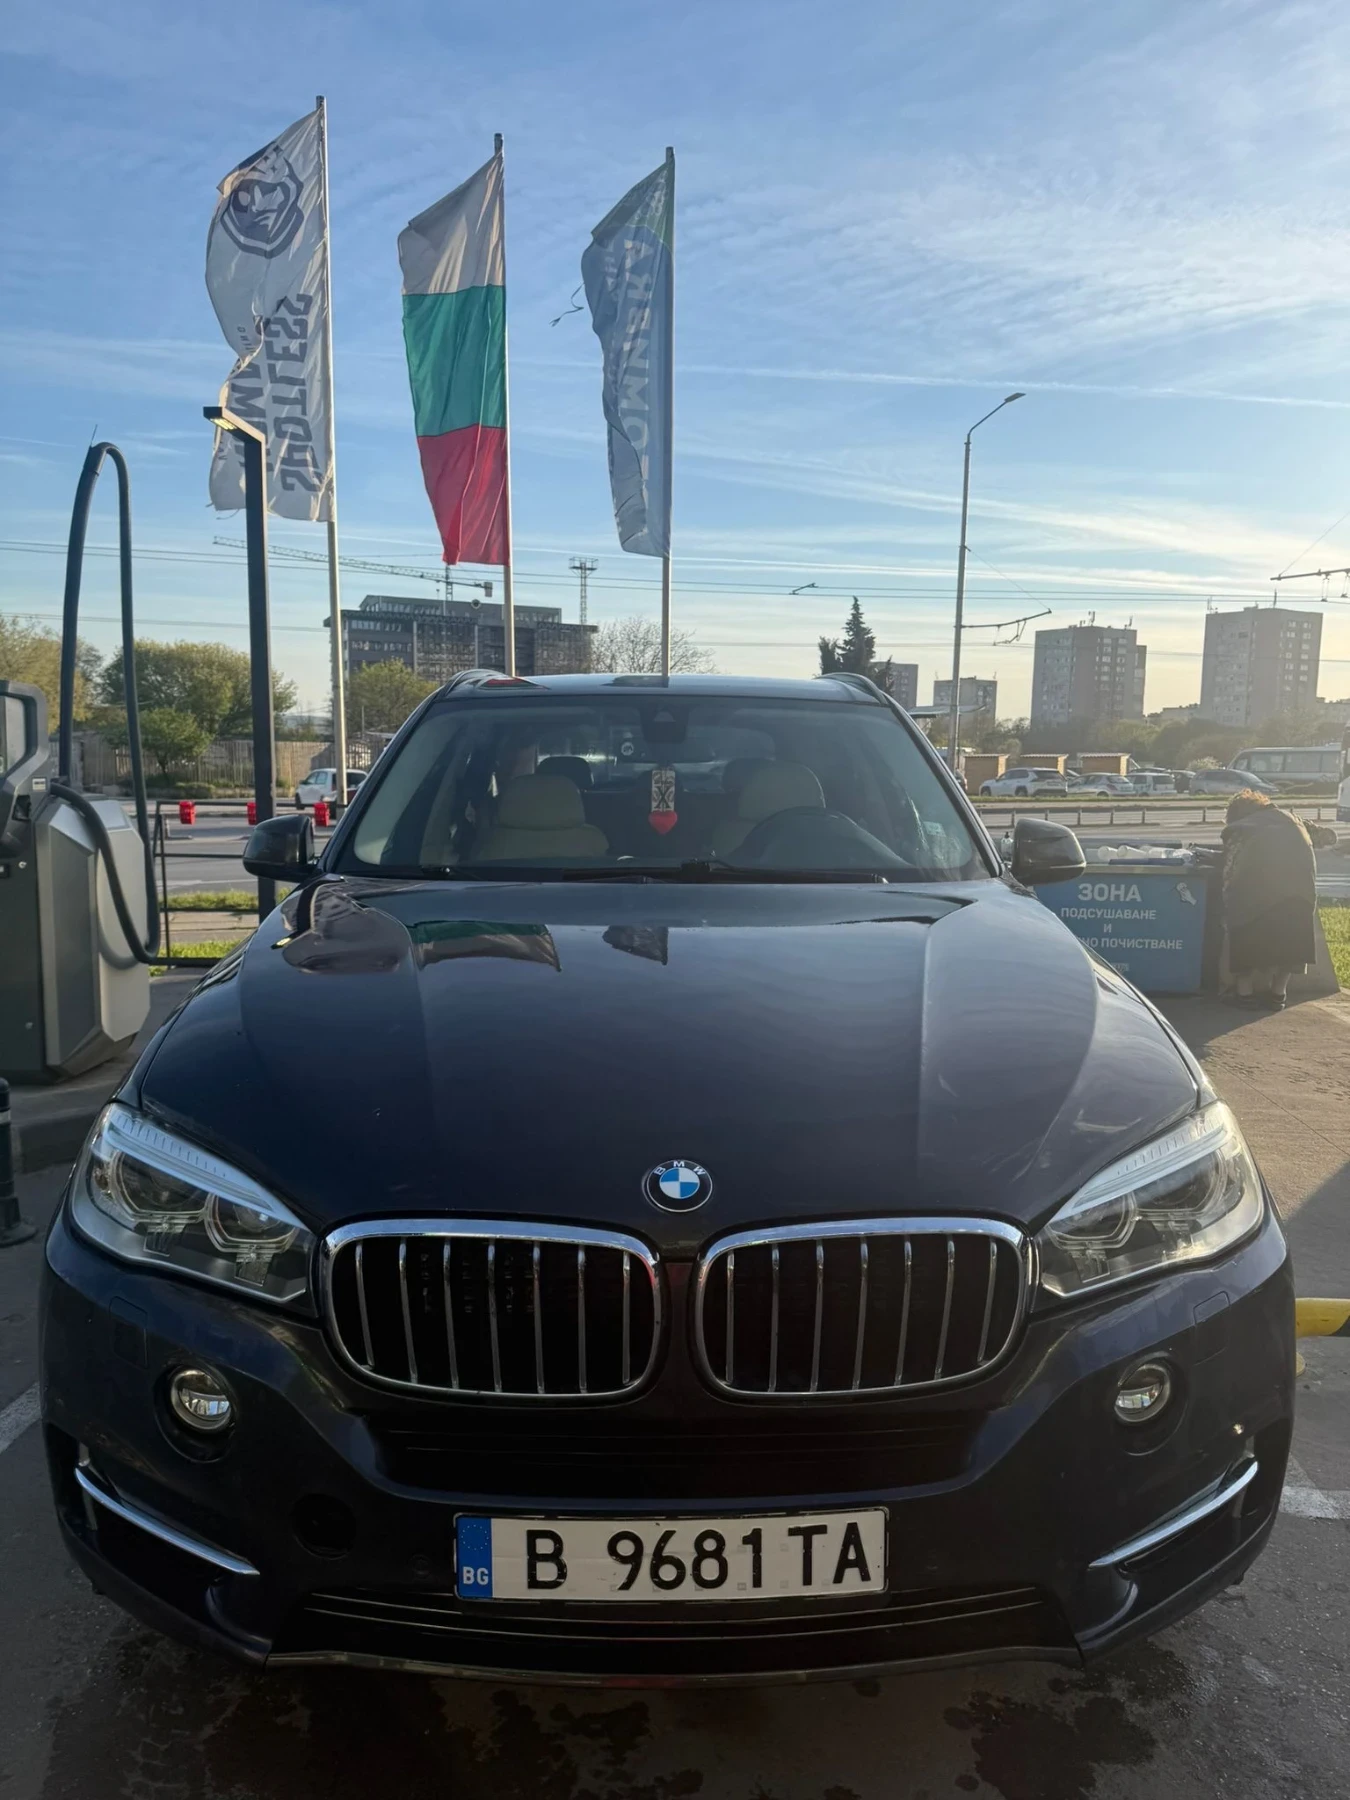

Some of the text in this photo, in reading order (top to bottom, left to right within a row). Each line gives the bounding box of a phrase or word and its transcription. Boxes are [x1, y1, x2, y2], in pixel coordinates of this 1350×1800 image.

[1078, 883, 1142, 902] ЗОНА
[1061, 907, 1157, 920] ПОДСУШАВАНЕ
[1103, 923, 1112, 933] И
[1101, 937, 1183, 950] ПОЧИСТВАНЕ
[653, 1160, 706, 1175] BMW
[526, 1522, 872, 1591] B 9681 TA
[462, 1566, 489, 1586] BG
